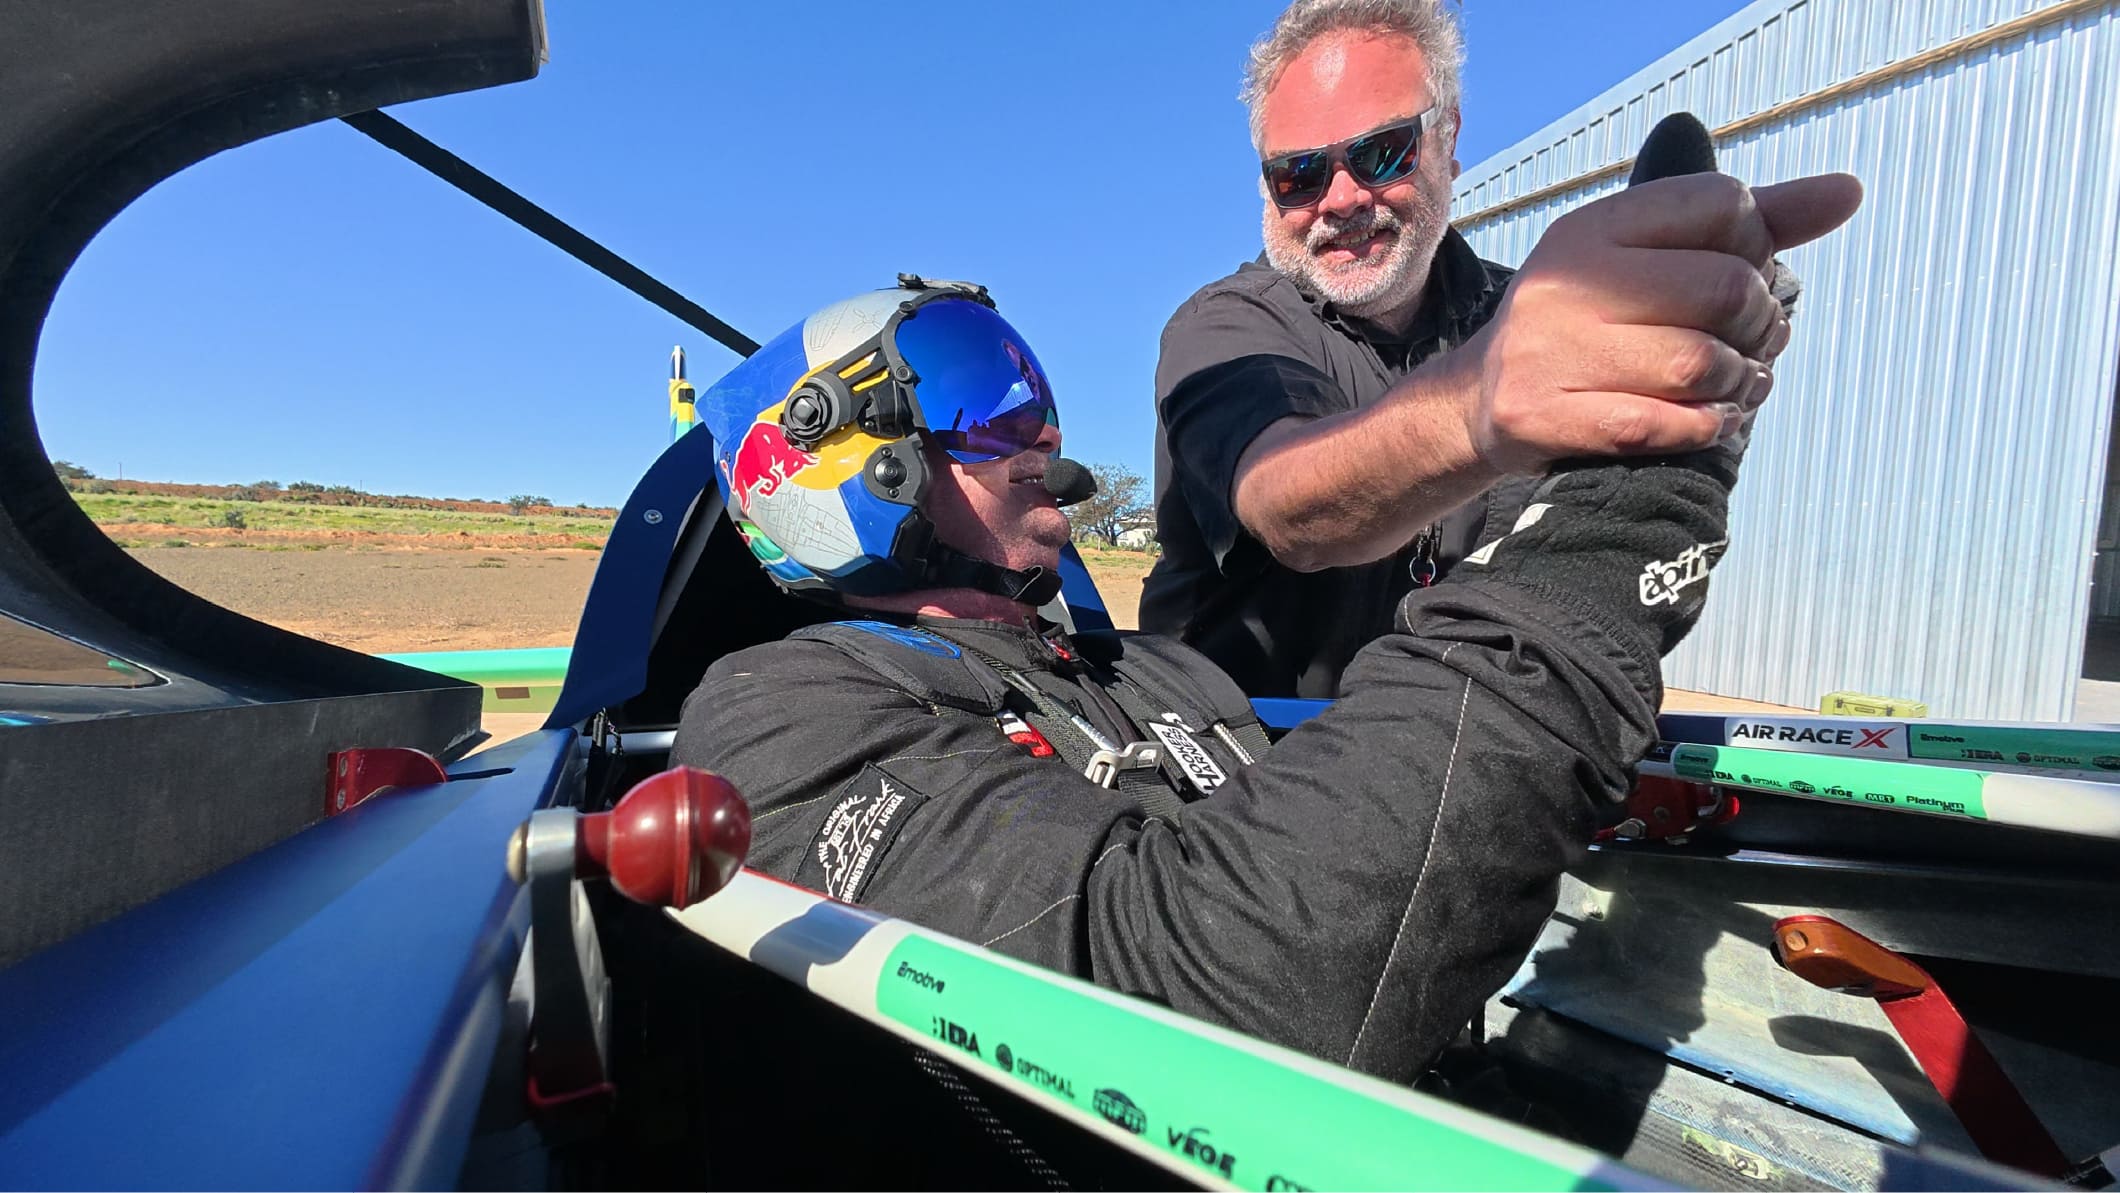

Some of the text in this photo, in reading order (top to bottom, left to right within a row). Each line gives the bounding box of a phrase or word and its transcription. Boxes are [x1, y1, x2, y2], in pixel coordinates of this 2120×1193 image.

[1732, 723, 1775, 740] AIR
[1778, 726, 1854, 746] RACE
[1162, 730, 1220, 790] HOOKER
[1906, 795, 1965, 808] Platinum
[818, 794, 867, 864] THE ORIGINAL
[841, 794, 906, 904] ENGINEERED IN AFRICA
[896, 961, 945, 994] Emotive
[1016, 1057, 1075, 1099] OPTIMAL
